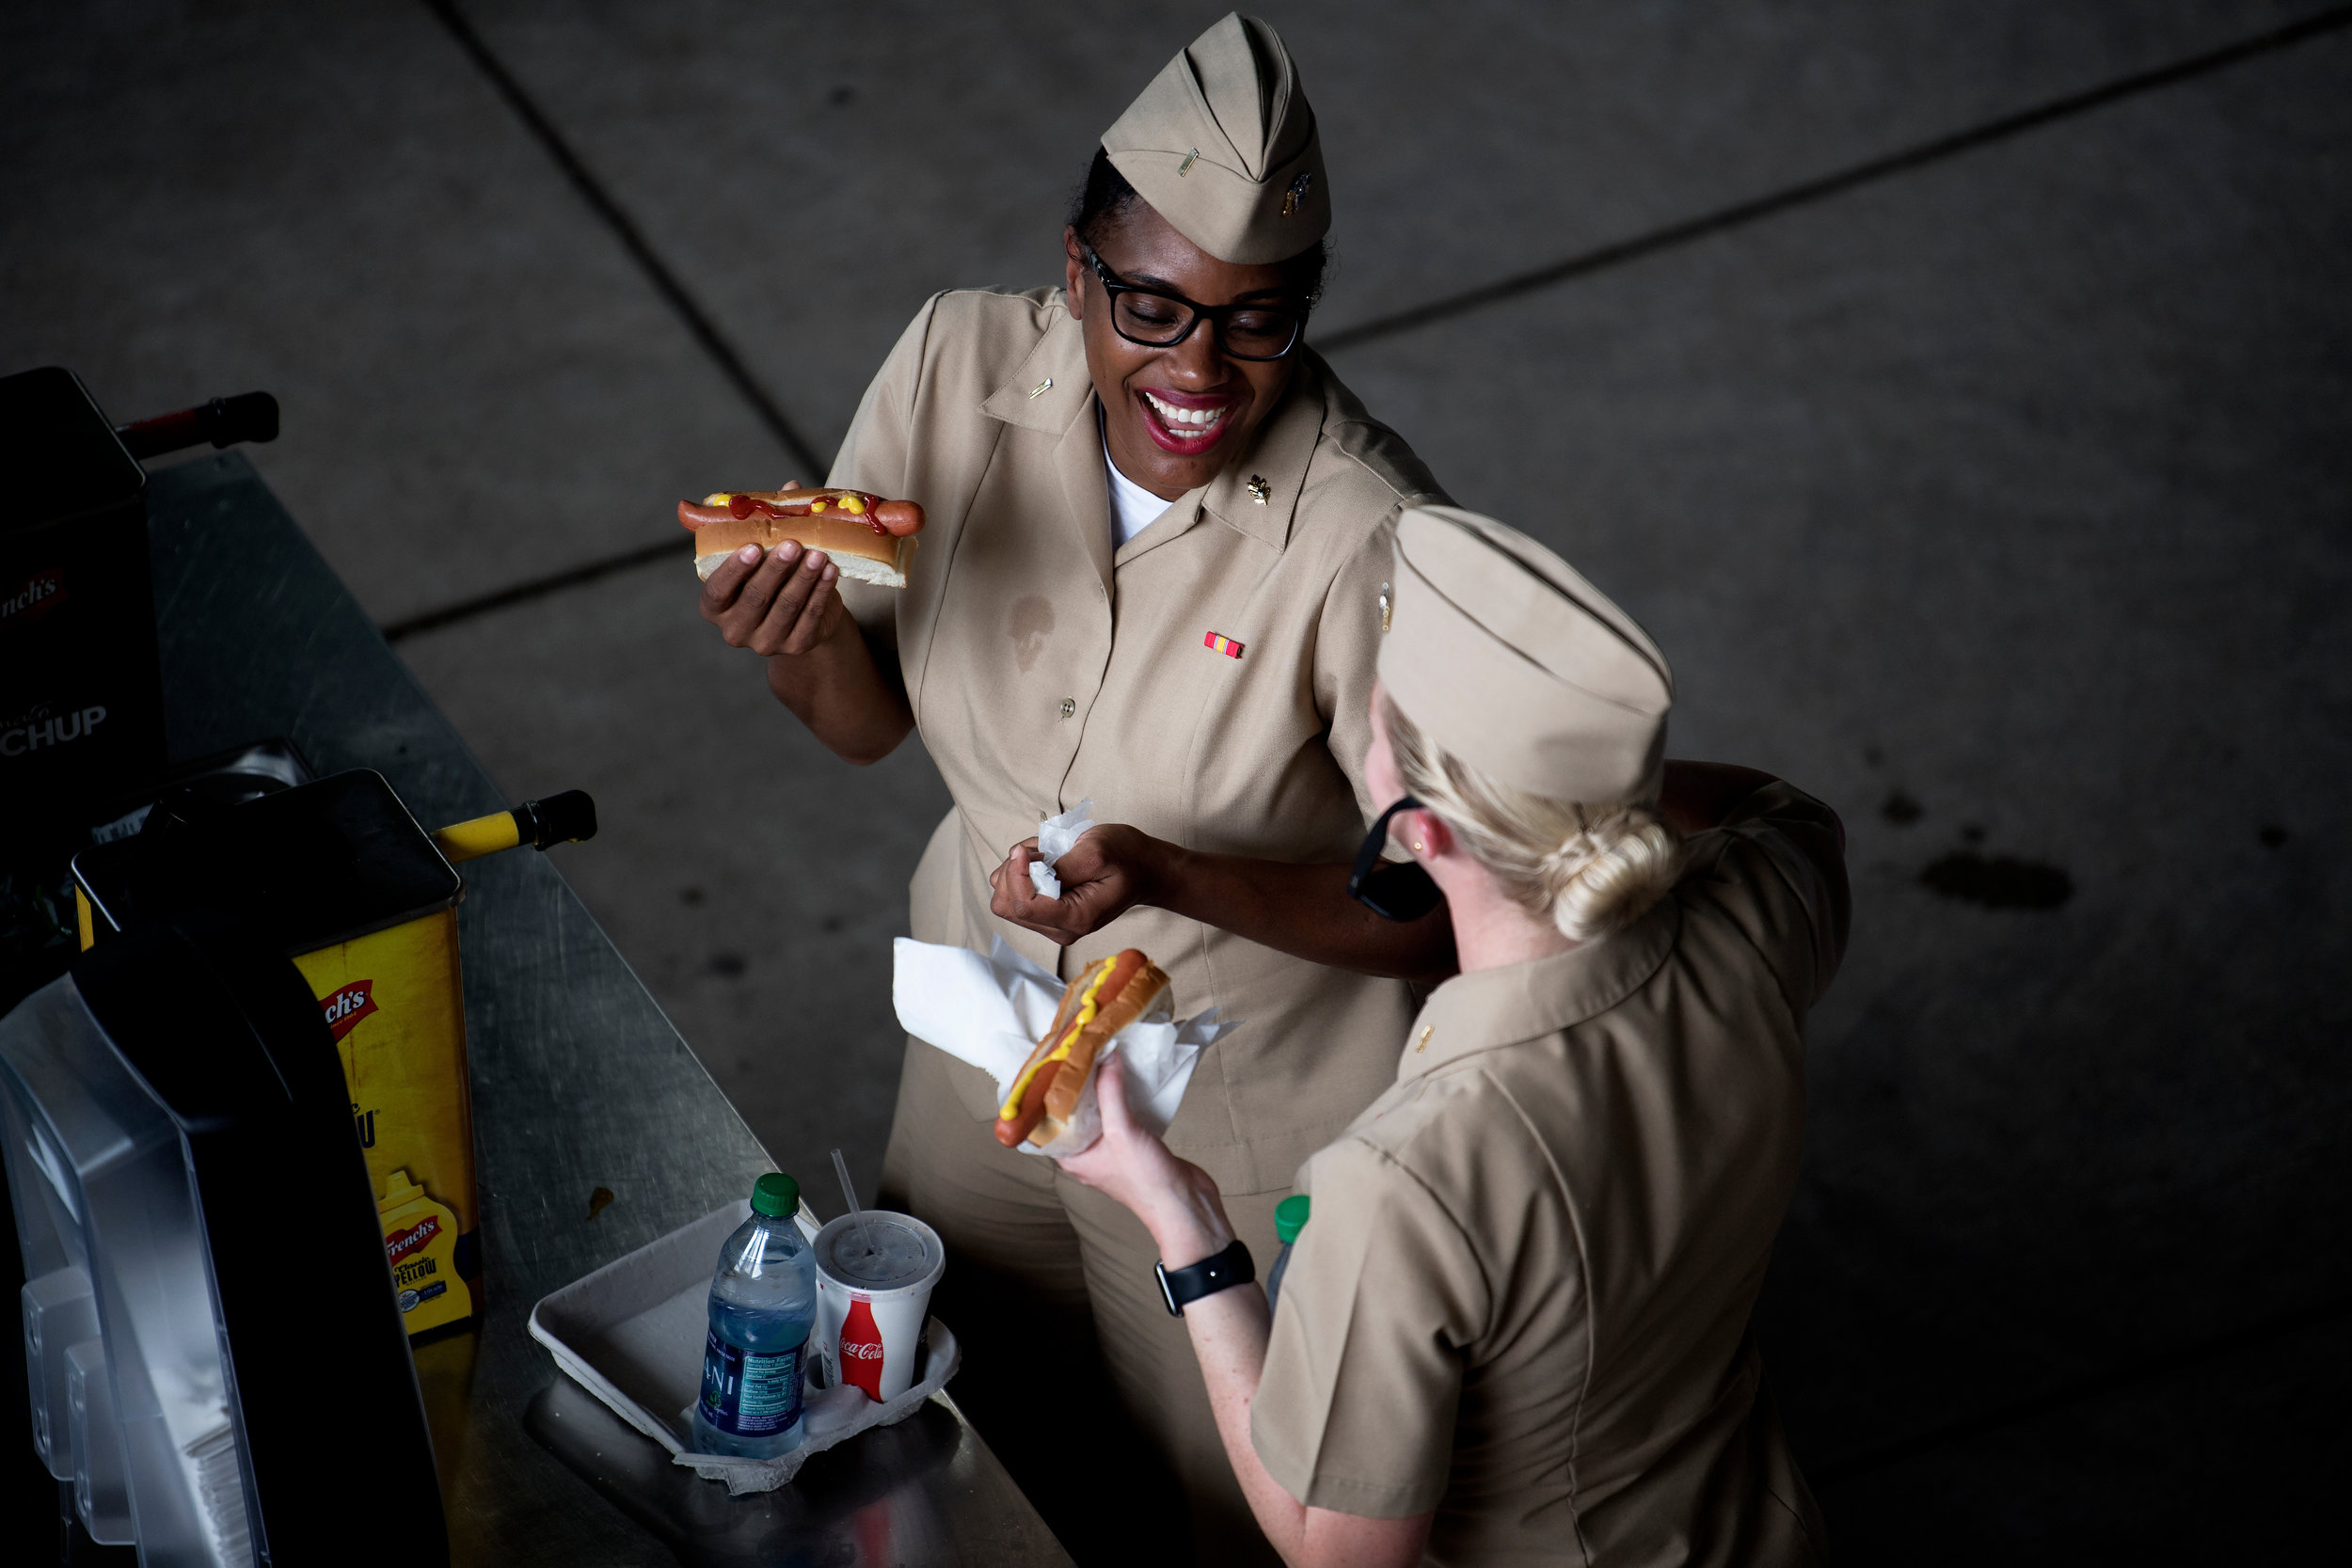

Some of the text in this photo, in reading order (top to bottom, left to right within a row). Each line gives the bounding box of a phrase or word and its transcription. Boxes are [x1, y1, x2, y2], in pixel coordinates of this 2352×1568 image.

[394, 1259, 437, 1288] YELLOW
[839, 1337, 883, 1360] Coca-Cola
[748, 1357, 775, 1366] Nutrition
